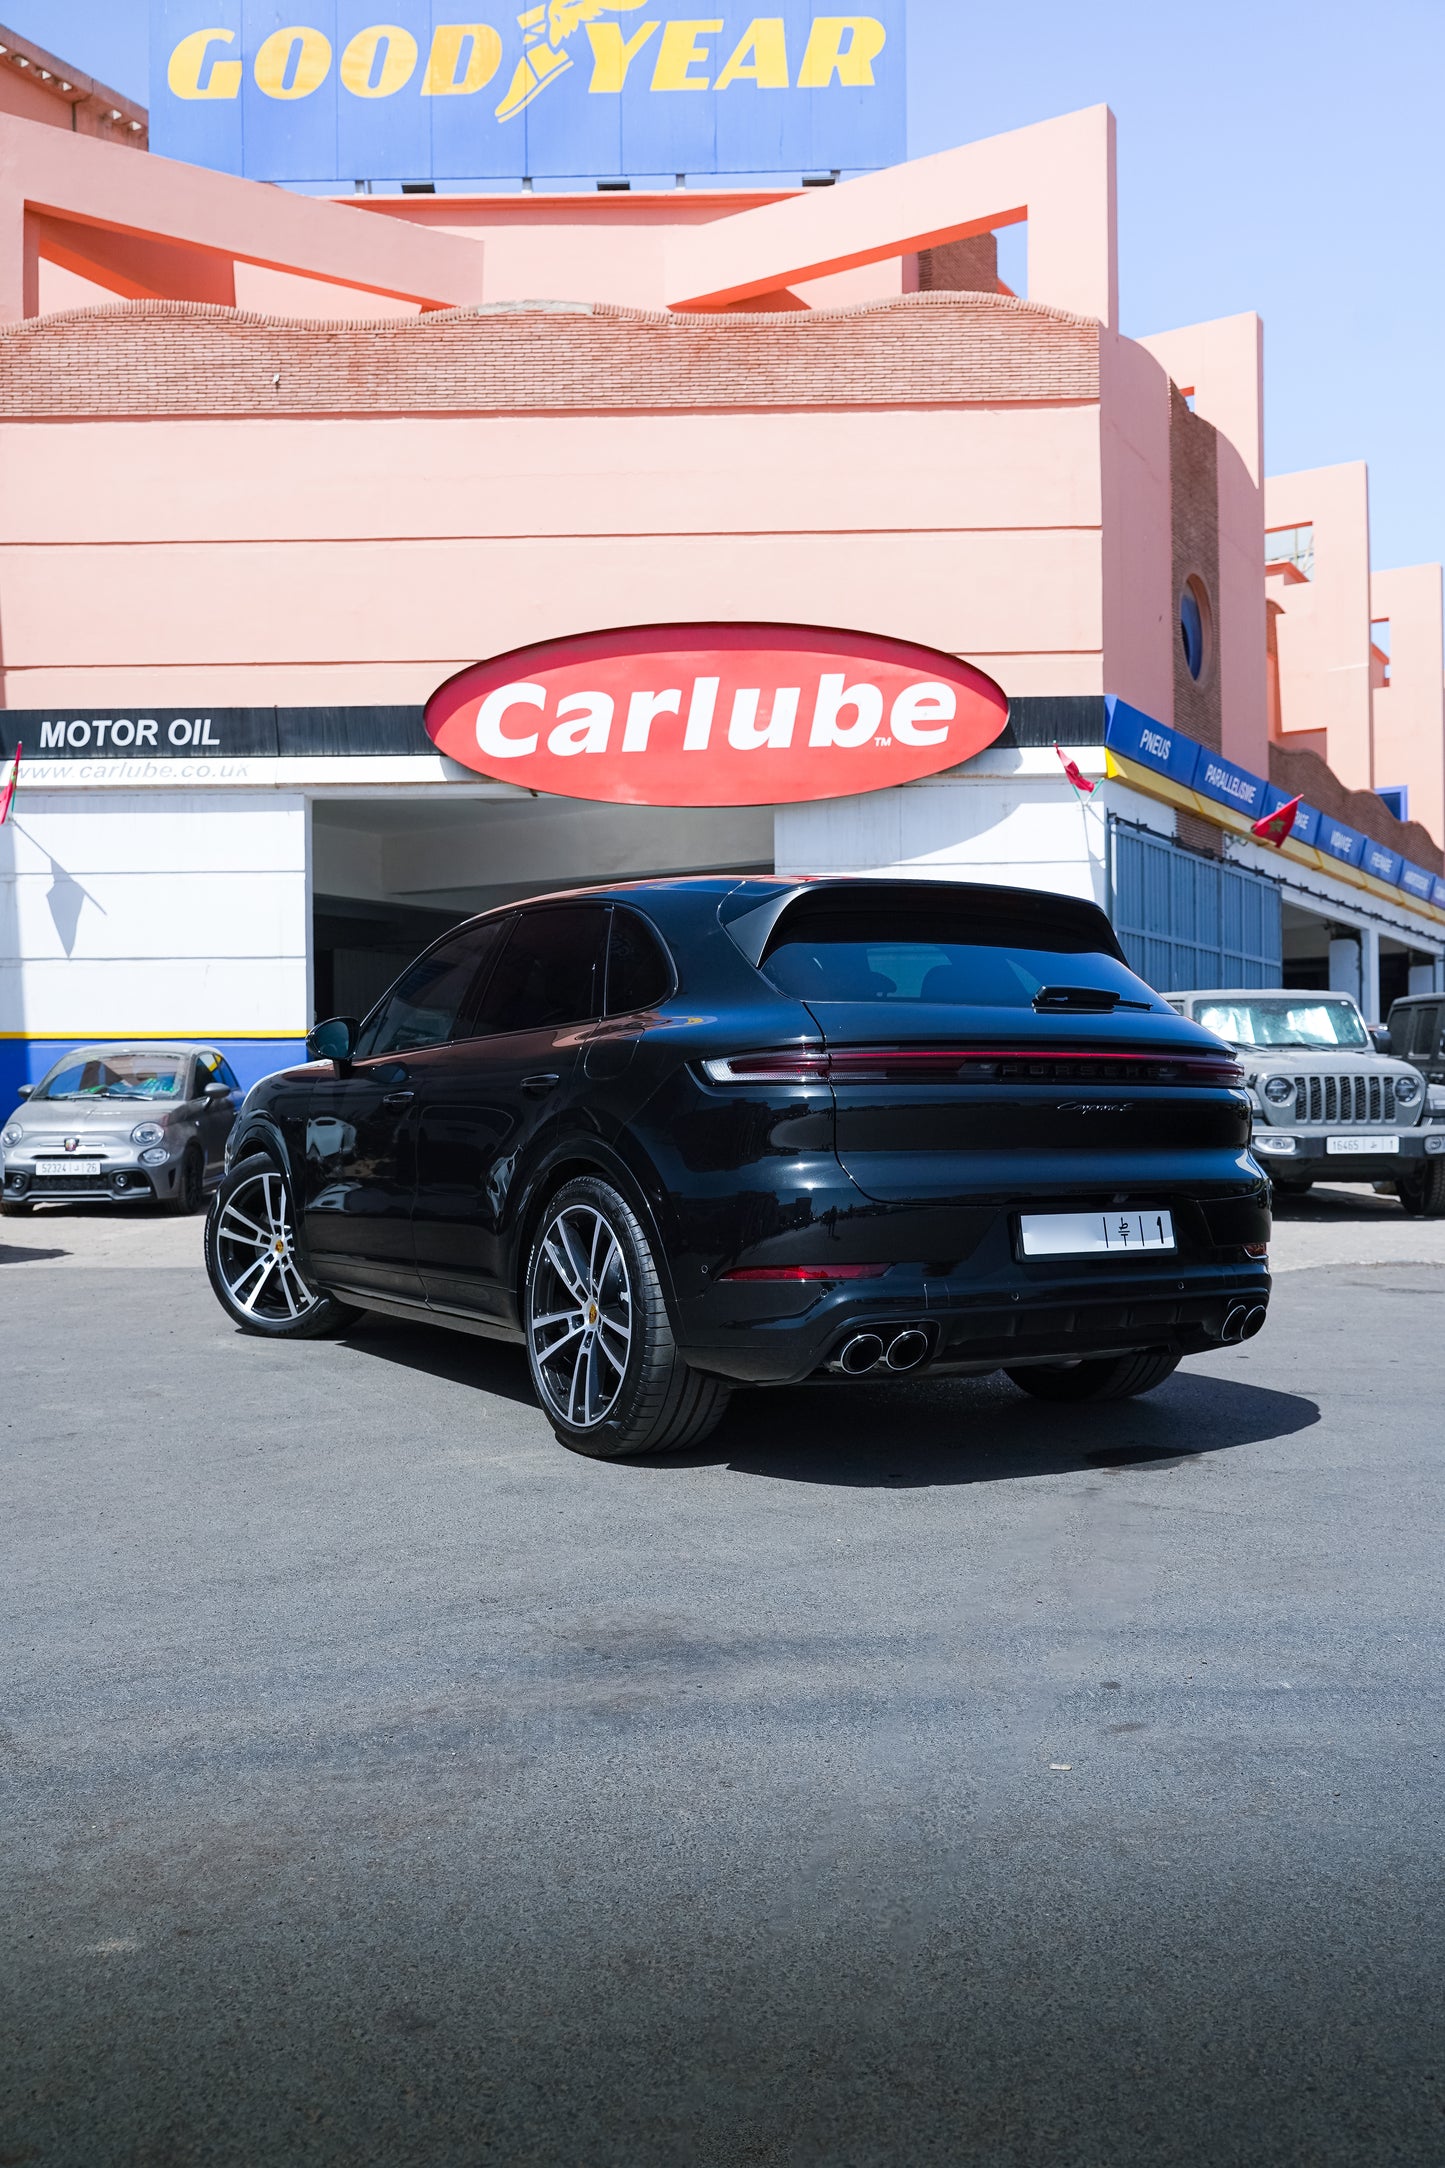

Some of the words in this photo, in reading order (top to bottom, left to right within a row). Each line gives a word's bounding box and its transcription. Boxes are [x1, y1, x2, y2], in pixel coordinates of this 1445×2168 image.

[167, 24, 503, 101] GOOD
[585, 16, 887, 93] YEAR
[40, 719, 159, 748] MOTOR
[168, 718, 221, 746] OIL
[475, 673, 957, 758] Carlube
[1139, 729, 1171, 760] PNEUS
